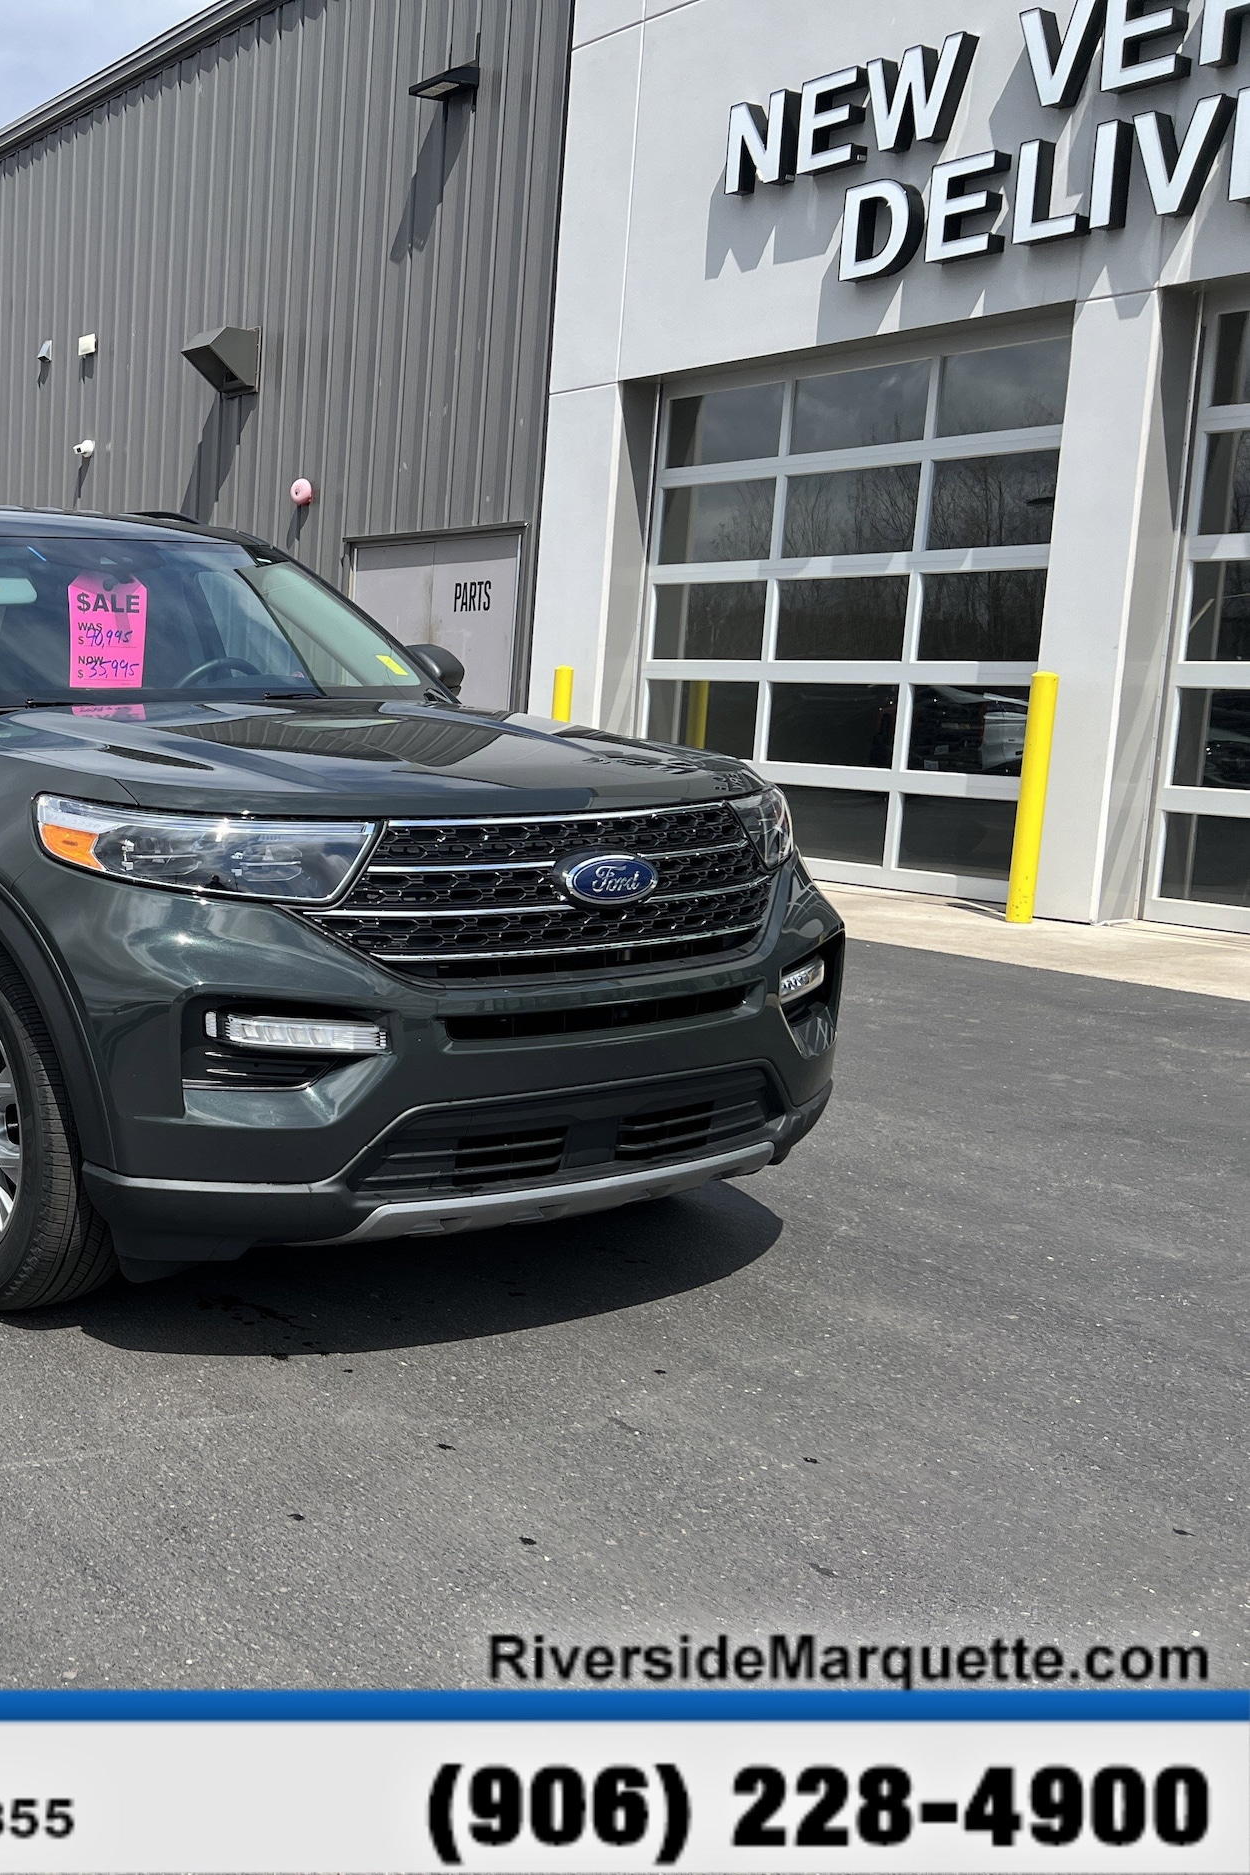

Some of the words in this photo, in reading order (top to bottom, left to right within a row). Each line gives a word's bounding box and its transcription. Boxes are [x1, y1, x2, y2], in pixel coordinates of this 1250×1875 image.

[724, 31, 978, 195] NEW
[76, 592, 140, 614] $ALE
[453, 580, 492, 612] PARTS
[77, 621, 103, 632] WAS
[78, 655, 104, 666] NOW
[592, 865, 640, 893] Ford
